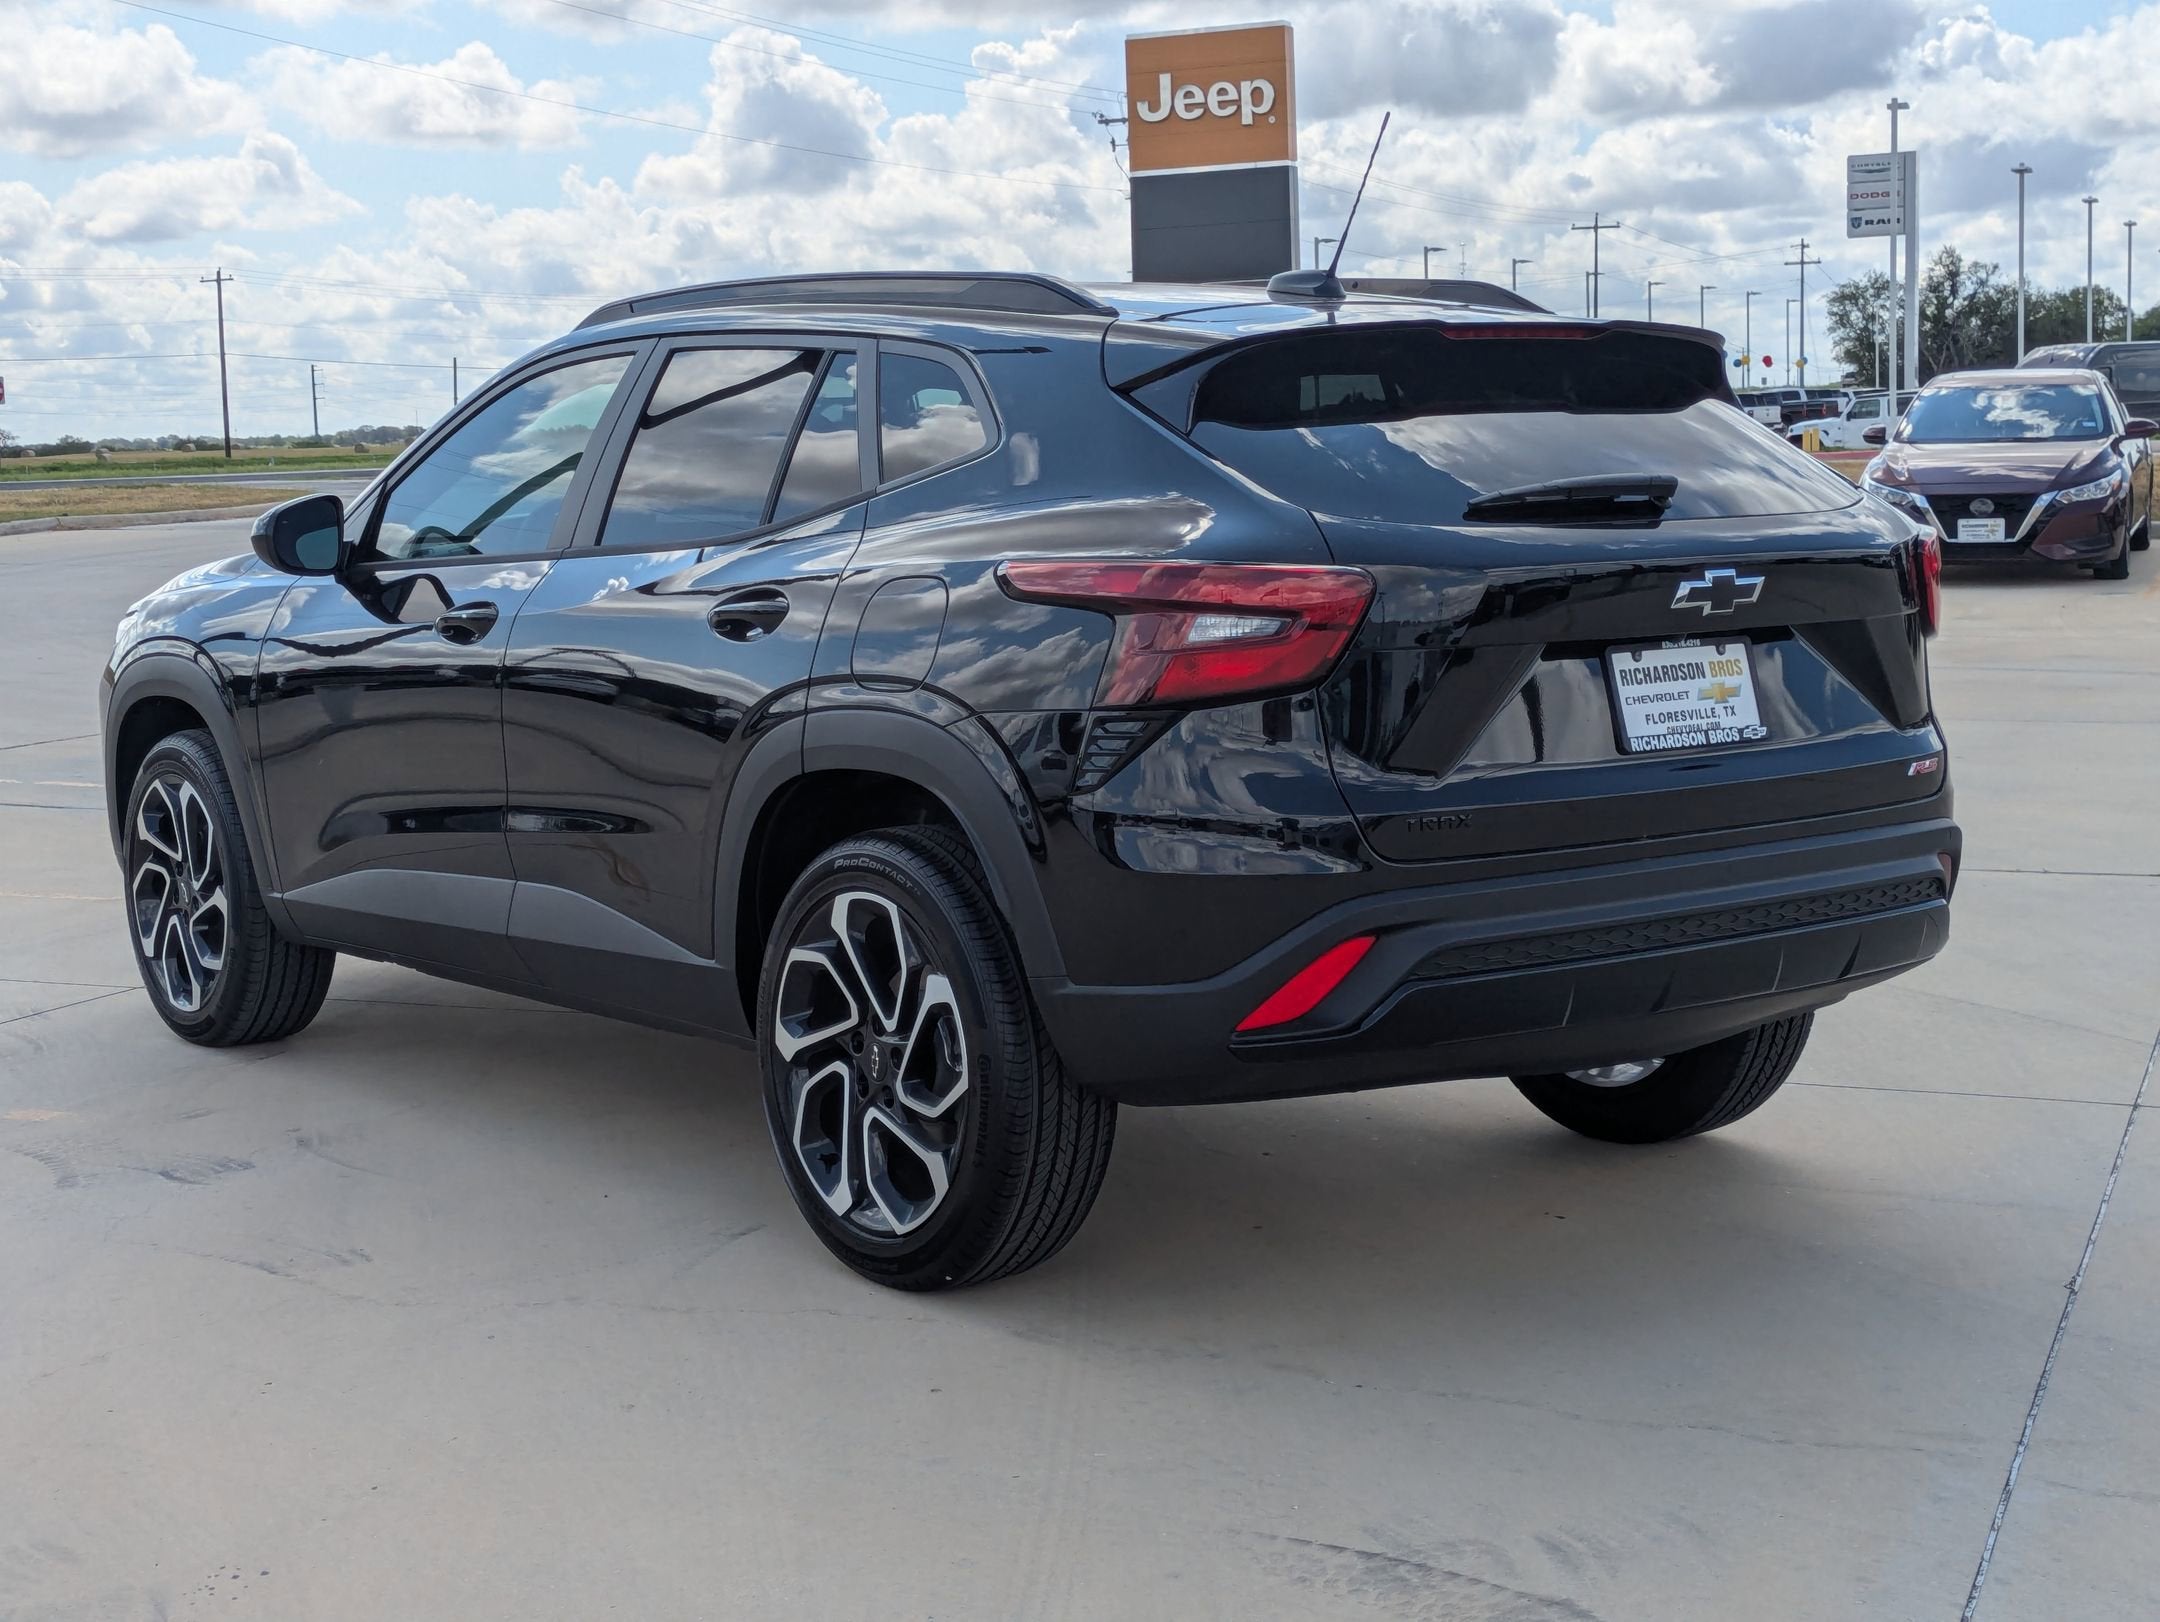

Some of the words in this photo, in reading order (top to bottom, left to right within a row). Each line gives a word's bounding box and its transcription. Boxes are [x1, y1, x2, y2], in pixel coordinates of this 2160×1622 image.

[1136, 73, 1275, 125] Jeep
[1619, 661, 1706, 687] RICHARDSON
[1709, 658, 1744, 678] BROS
[1625, 690, 1690, 706] CHEVROLET
[1645, 707, 1721, 726] FLORESVILLE,
[1723, 705, 1737, 717] TX
[1630, 732, 1707, 752] RICHARDSON
[1709, 727, 1740, 745] BROS
[1908, 758, 1939, 776] RS
